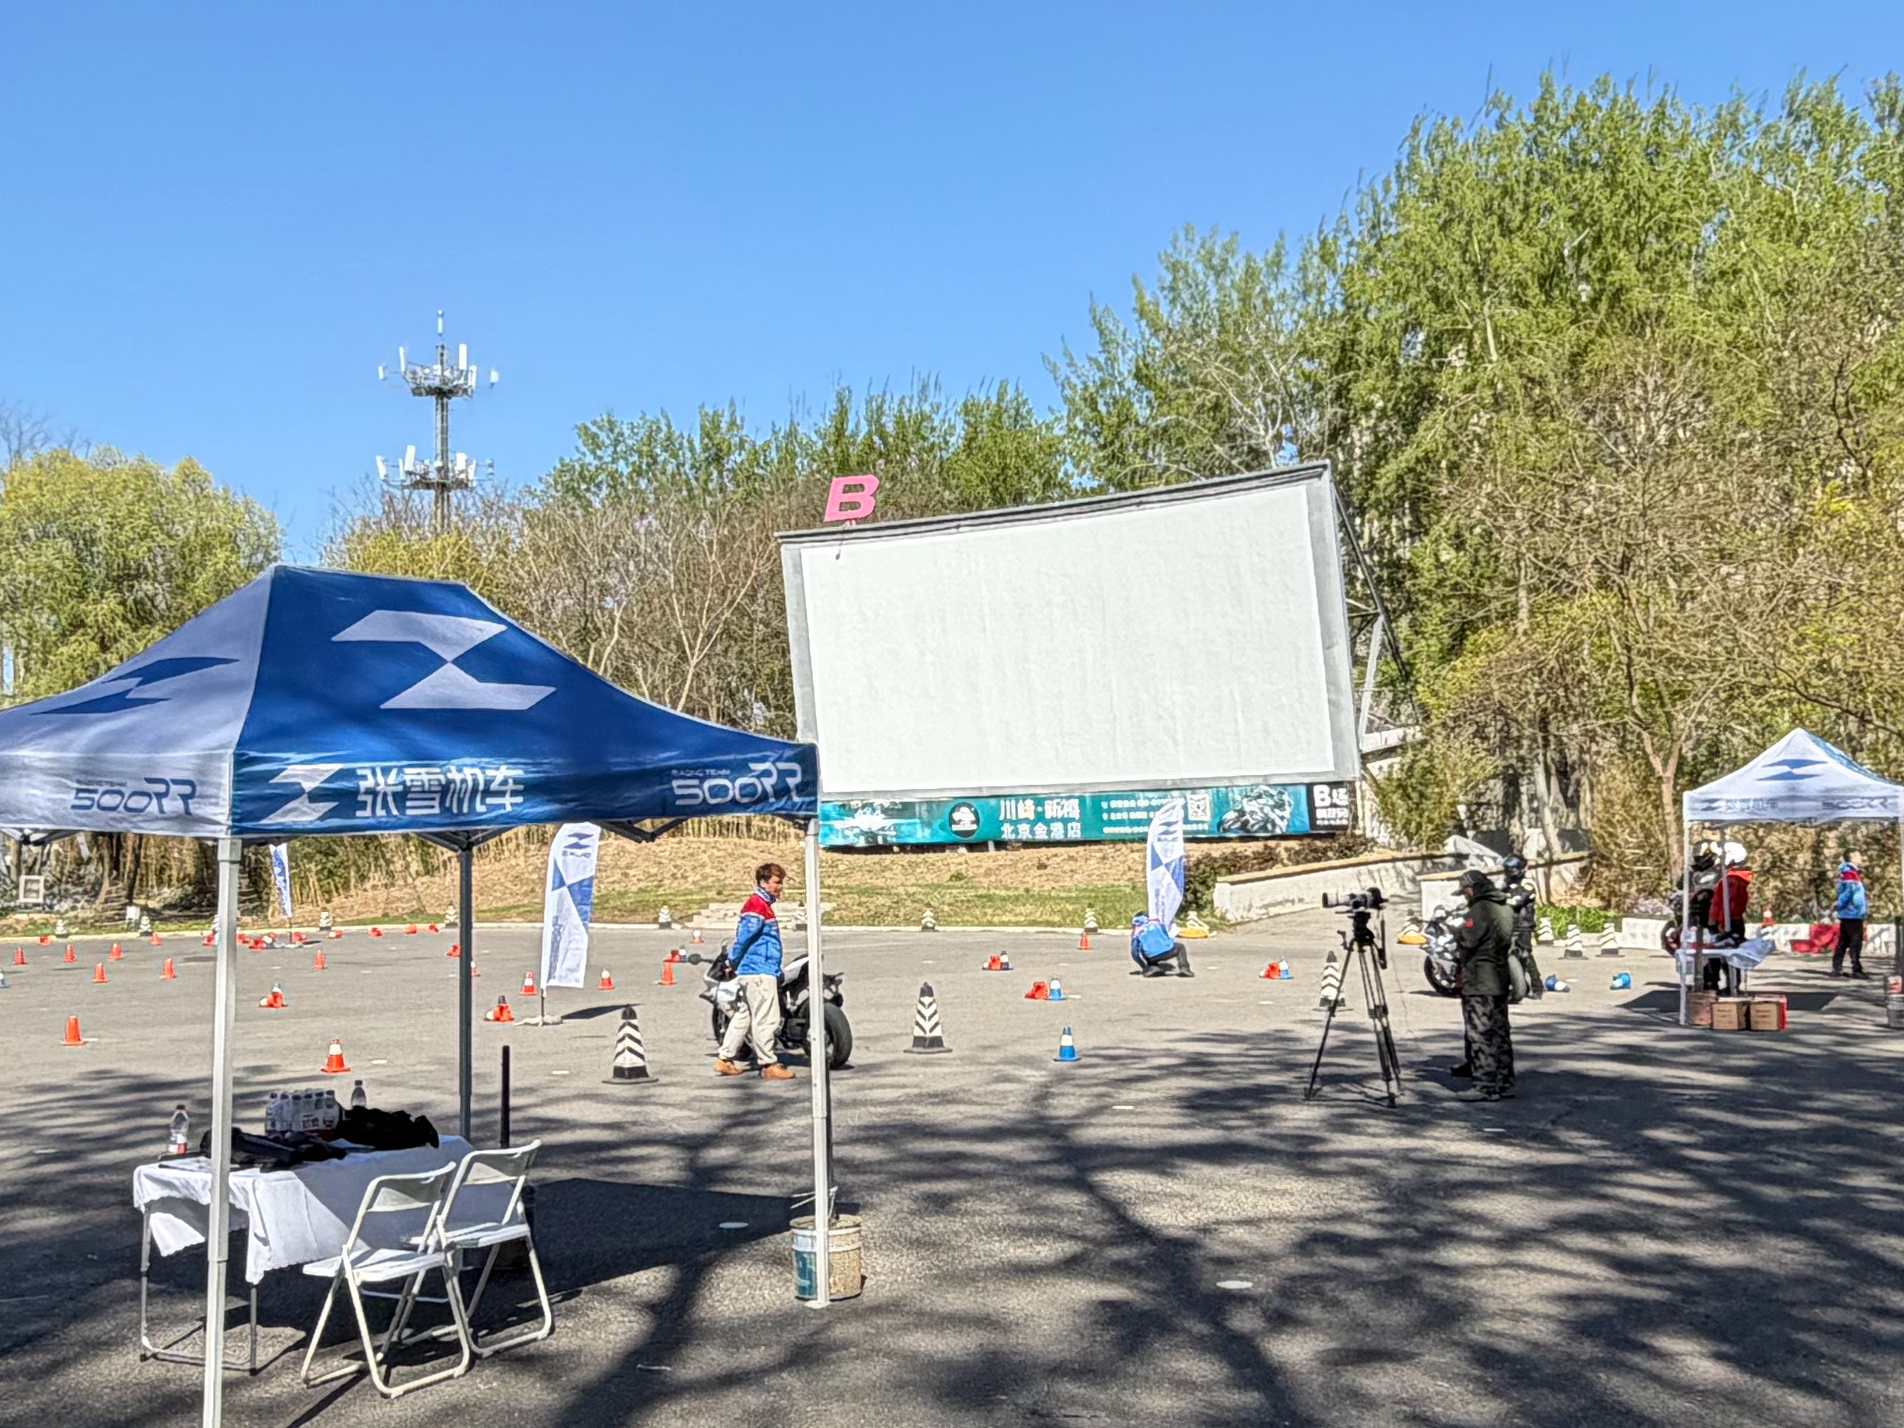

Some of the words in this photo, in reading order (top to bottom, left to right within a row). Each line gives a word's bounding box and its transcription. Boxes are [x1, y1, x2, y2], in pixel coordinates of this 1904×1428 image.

[824, 474, 880, 522] B
[356, 765, 525, 817] 张雪机车
[671, 762, 802, 805] 500RR
